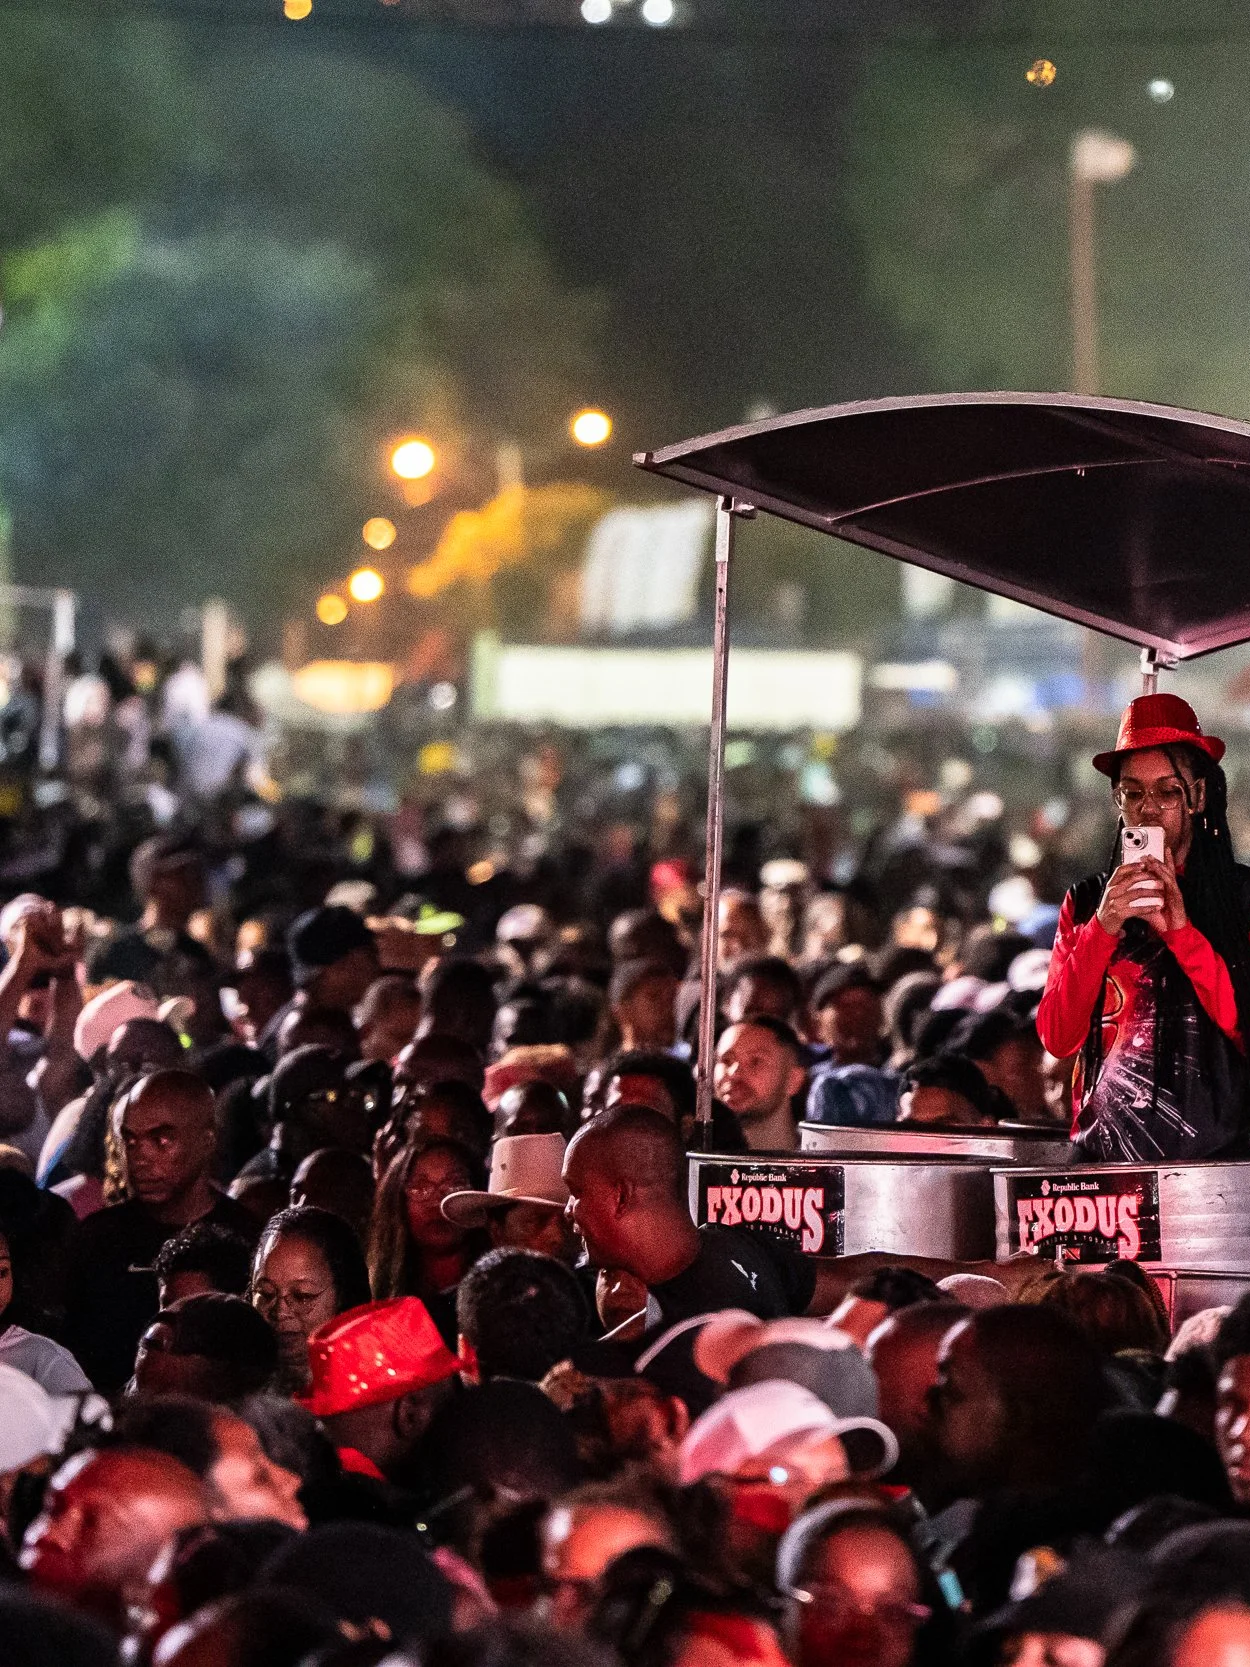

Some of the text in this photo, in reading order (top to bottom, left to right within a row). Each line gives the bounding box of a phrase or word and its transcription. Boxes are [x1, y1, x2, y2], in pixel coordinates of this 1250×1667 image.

[741, 1173, 786, 1182] Republic Bank
[1052, 1182, 1100, 1192] Republic Bank
[1017, 1193, 1139, 1260] EXODUS
